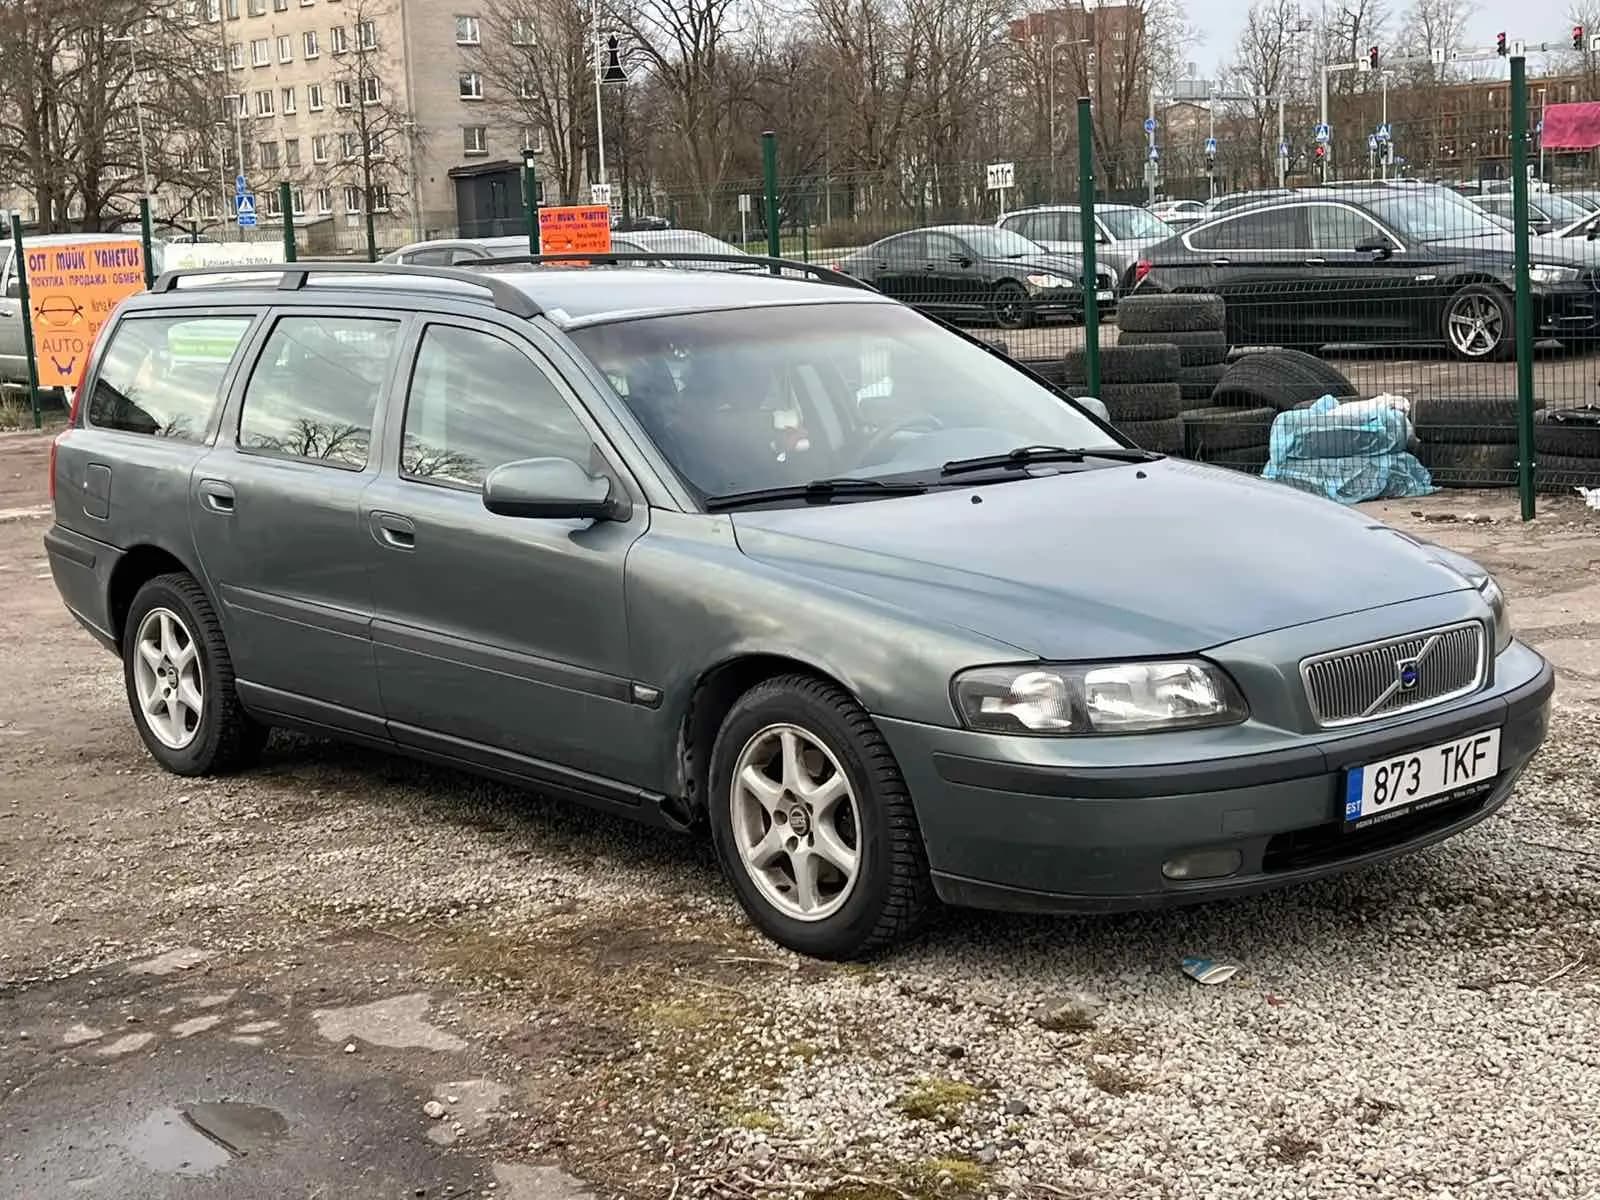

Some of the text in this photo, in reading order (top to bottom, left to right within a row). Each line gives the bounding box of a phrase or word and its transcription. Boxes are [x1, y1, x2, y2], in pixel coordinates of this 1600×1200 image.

[29, 247, 139, 272] OST MÜÜK VAHETUS
[31, 271, 140, 288] ПОКУПКА ПРОДАЖА ОБМЕН
[42, 338, 84, 353] AUTO
[1374, 736, 1491, 805] 873 TKF
[1345, 801, 1361, 815] EST
